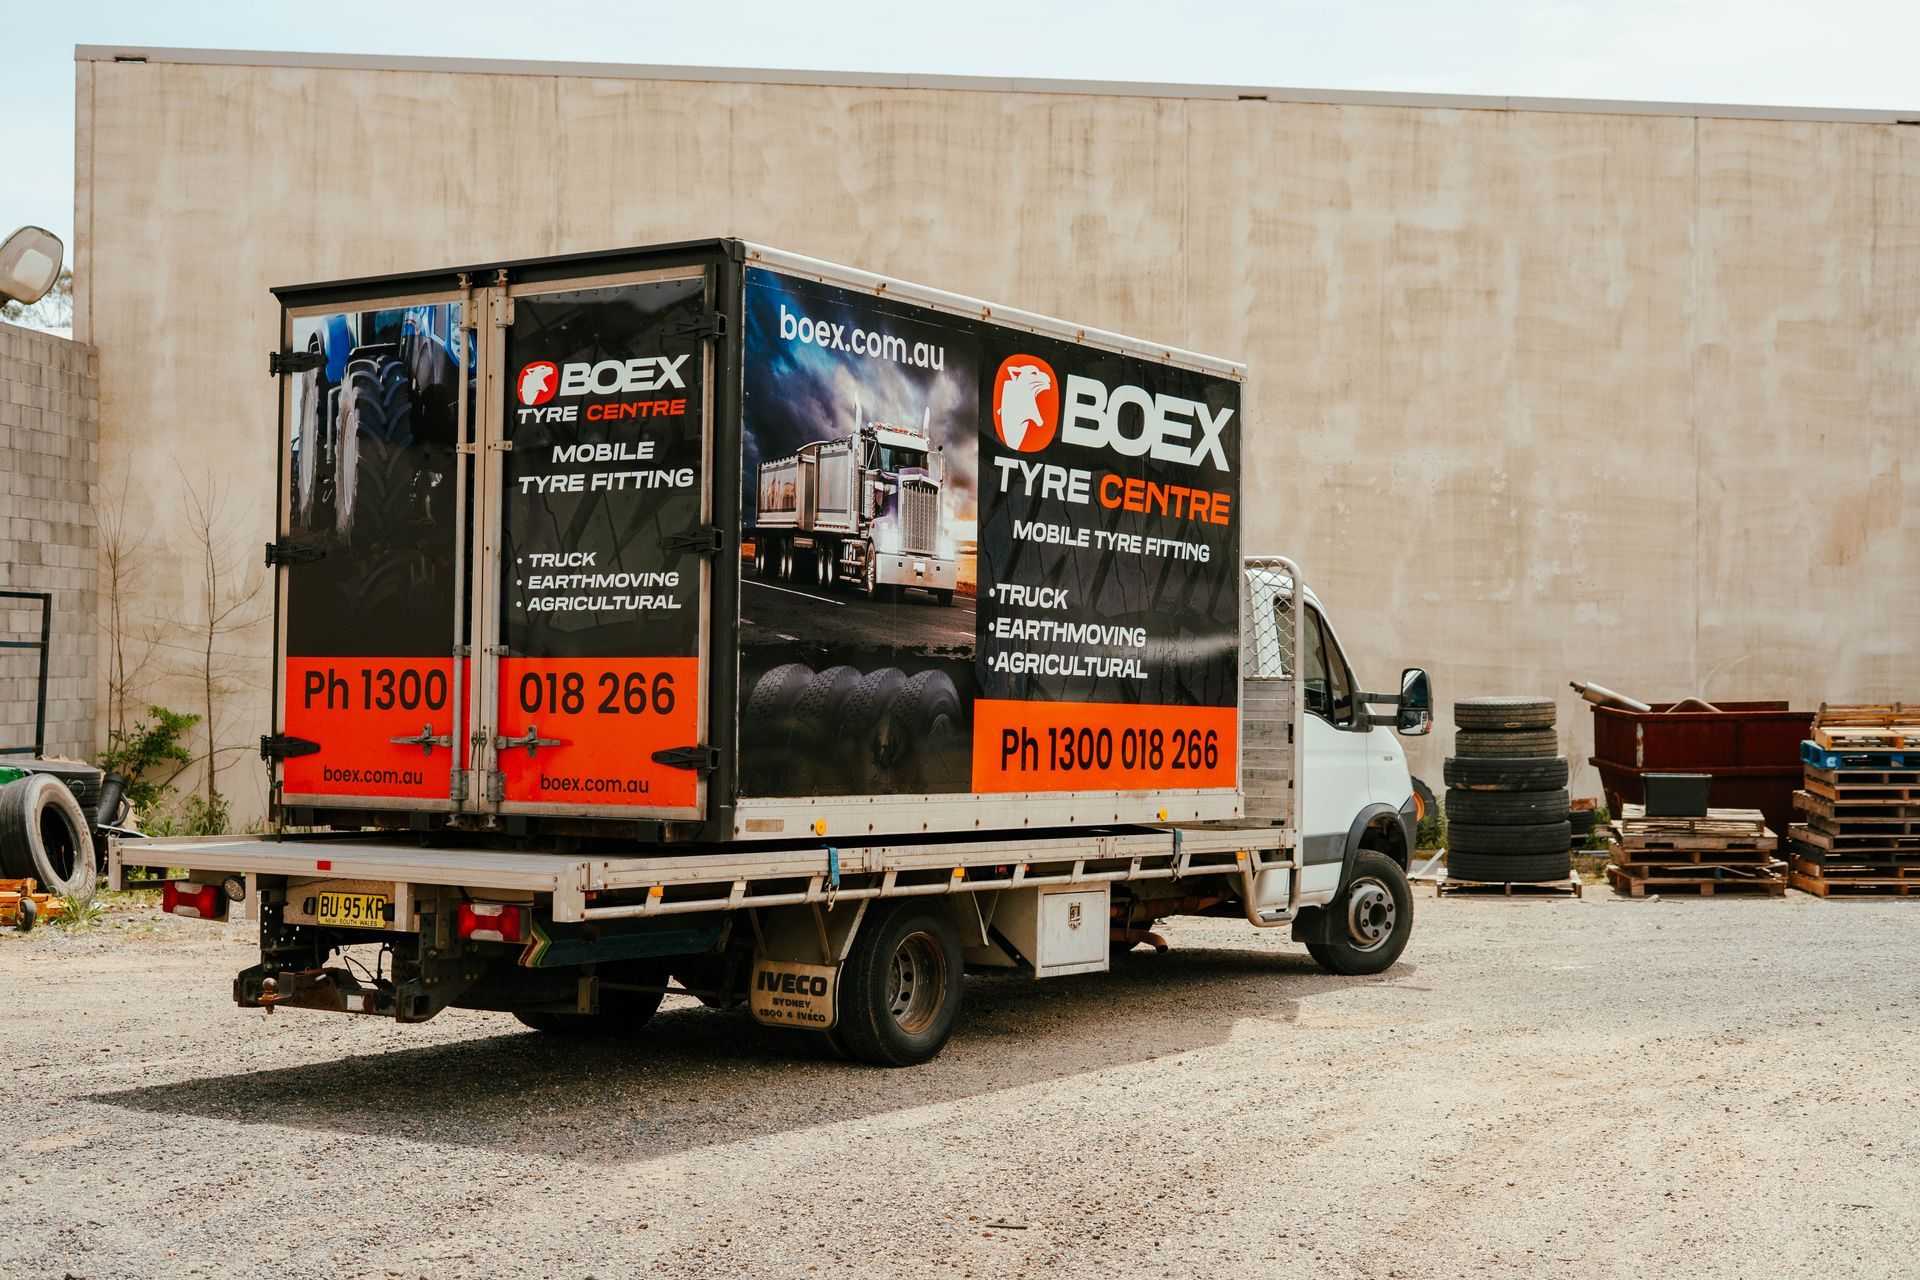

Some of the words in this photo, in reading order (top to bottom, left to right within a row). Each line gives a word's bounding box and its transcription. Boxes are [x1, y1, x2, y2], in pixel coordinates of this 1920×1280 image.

[781, 305, 943, 371] boex.com.au
[560, 354, 690, 396] BOEX
[518, 405, 578, 424] TYRE
[587, 399, 686, 420] CENTRE
[1061, 374, 1235, 472] BOEX
[552, 442, 654, 463] MOBILE
[519, 474, 585, 494] TYRE
[591, 469, 693, 491] FITTING
[994, 456, 1091, 504] TYRE
[1100, 474, 1230, 525] CENTRE
[1013, 520, 1090, 547] MOBILE
[1094, 530, 1142, 553] TYRE
[1145, 537, 1209, 562] FITTING
[529, 552, 596, 567] TRUCK
[528, 572, 679, 589] EARTHMOVING
[527, 595, 681, 611] AGRICULTURAL
[305, 669, 348, 709] Ph
[362, 669, 447, 710] 1300
[520, 672, 584, 714] 018
[598, 672, 674, 715] 266
[1002, 727, 1038, 771] Ph
[1049, 727, 1112, 770] 1300
[1122, 728, 1163, 770] 018
[1172, 729, 1217, 769] 266
[324, 766, 422, 784] boex.com.au
[541, 774, 648, 793] boex.com.au
[758, 971, 827, 997] IVECO
[760, 1008, 783, 1018] 1300
[787, 1011, 793, 1020] 4
[797, 1012, 826, 1023] IVECO
[772, 997, 811, 1009] SYDNEY
